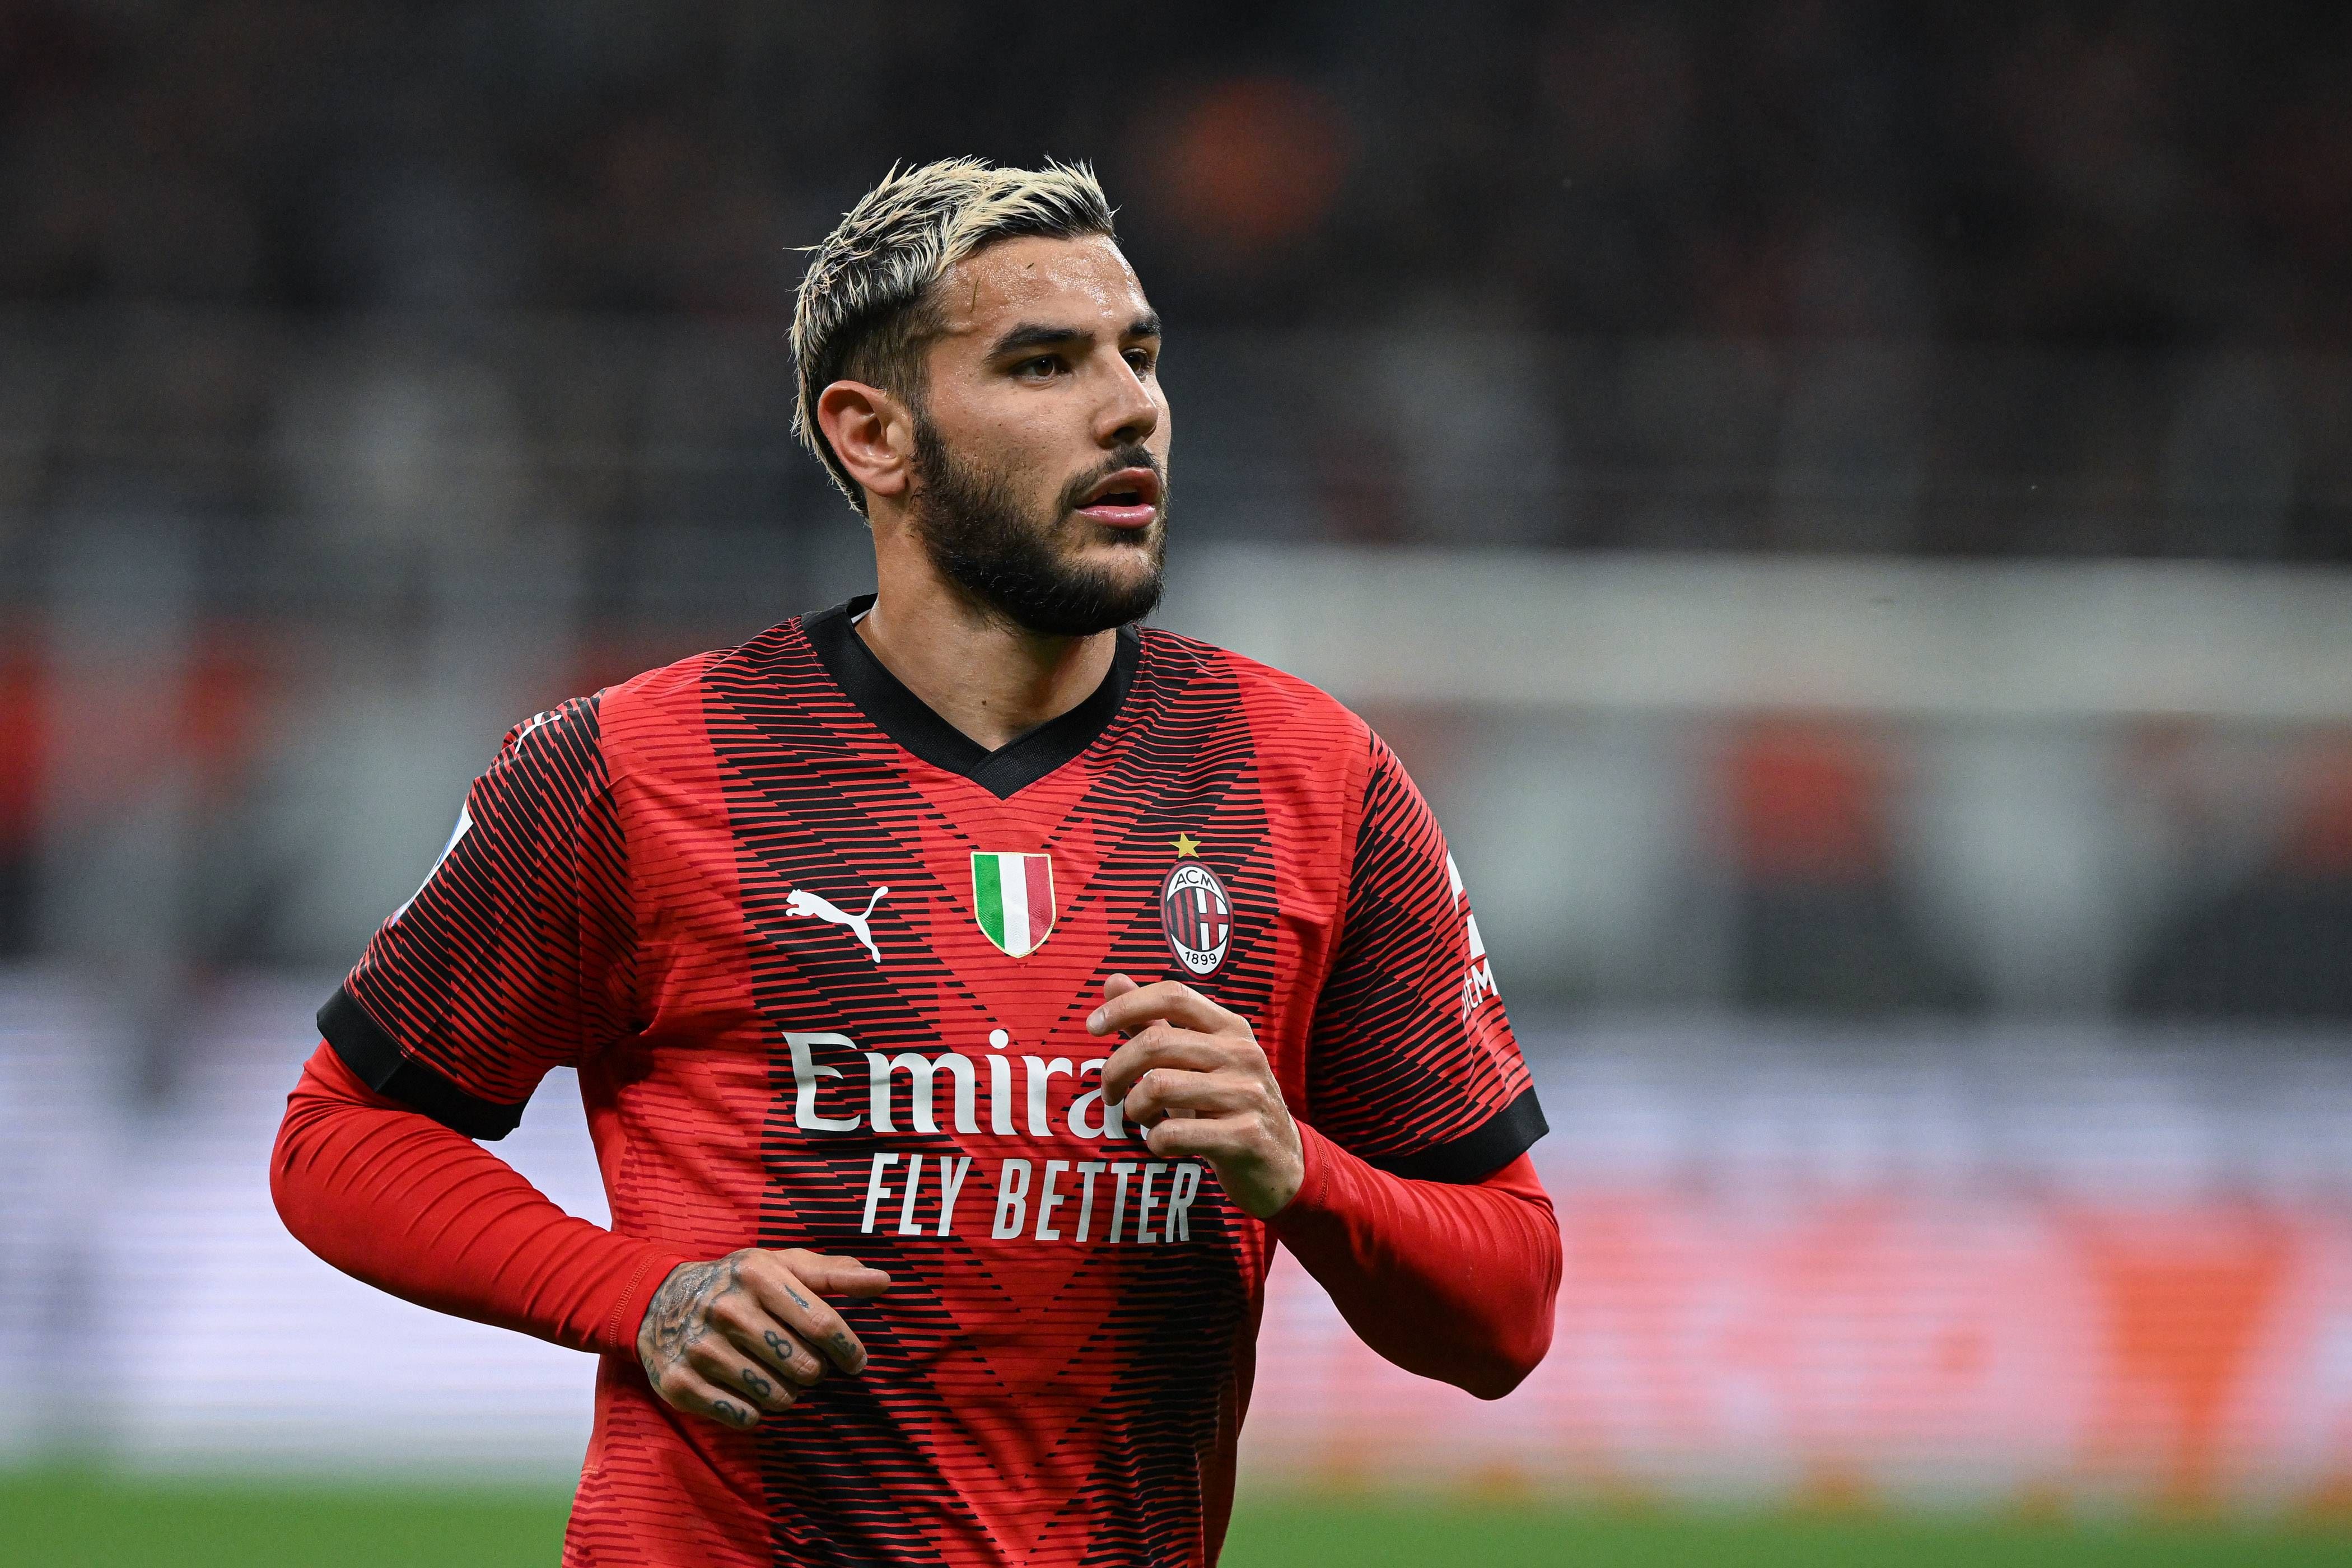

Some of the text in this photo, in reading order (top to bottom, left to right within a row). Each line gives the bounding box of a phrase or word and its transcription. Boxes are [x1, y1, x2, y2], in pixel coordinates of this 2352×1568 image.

[1174, 870, 1215, 890] ACM
[1184, 951, 1217, 965] 1899
[782, 1029, 1196, 1140] Emira
[861, 1152, 1202, 1244] FLY BETTER
